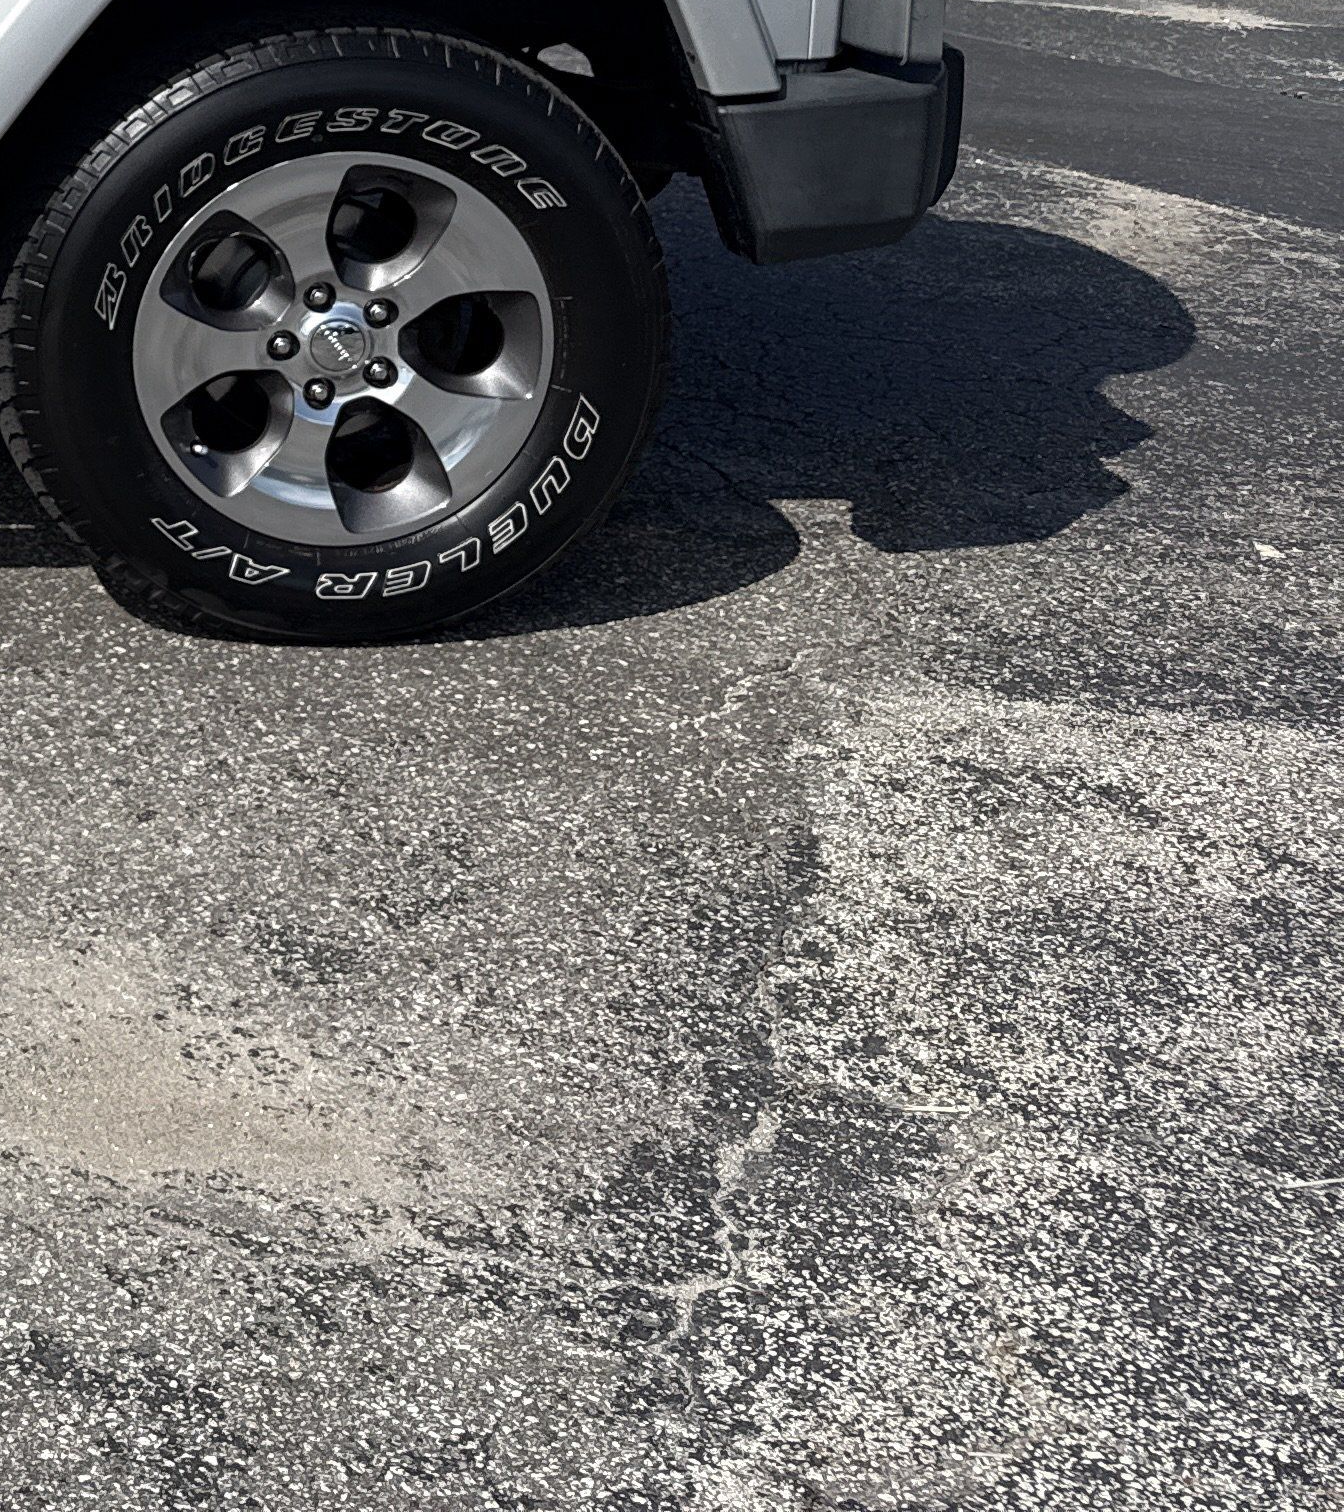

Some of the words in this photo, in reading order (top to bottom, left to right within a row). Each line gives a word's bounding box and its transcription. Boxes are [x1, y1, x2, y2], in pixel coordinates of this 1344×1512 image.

[94, 106, 567, 331] BRIDGESTONE
[151, 516, 294, 586] A/T
[315, 393, 602, 600] DUELER
